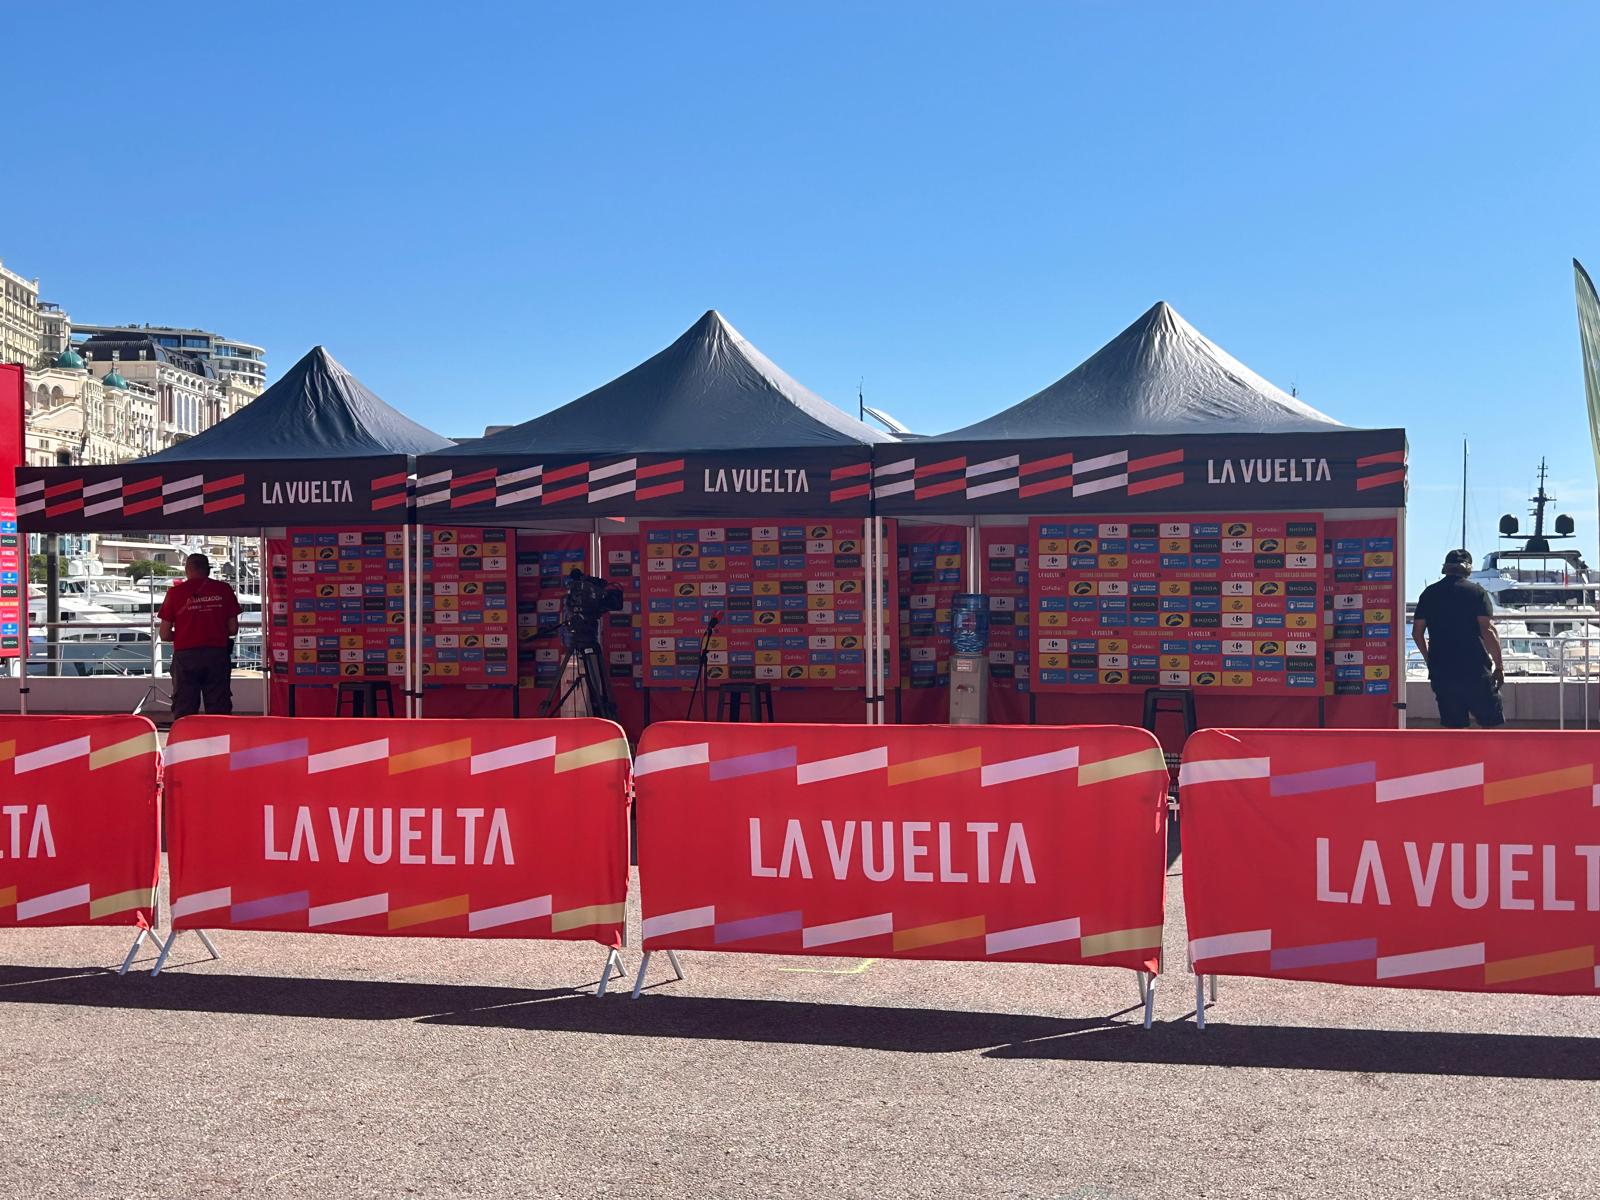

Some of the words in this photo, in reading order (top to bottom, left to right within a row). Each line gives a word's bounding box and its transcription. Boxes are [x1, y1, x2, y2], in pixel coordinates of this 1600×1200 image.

[262, 481, 283, 504] LA
[285, 480, 353, 504] VUELTA
[704, 468, 728, 493] LA
[731, 468, 809, 493] VUELTA
[1207, 459, 1236, 484] LA
[1239, 458, 1332, 483] VUELTA
[0, 804, 56, 859] TA
[264, 804, 320, 862] LA
[328, 806, 515, 865] VUELTA
[749, 817, 813, 879] LA
[821, 819, 1037, 884] VUELTA
[1316, 837, 1392, 906] LA
